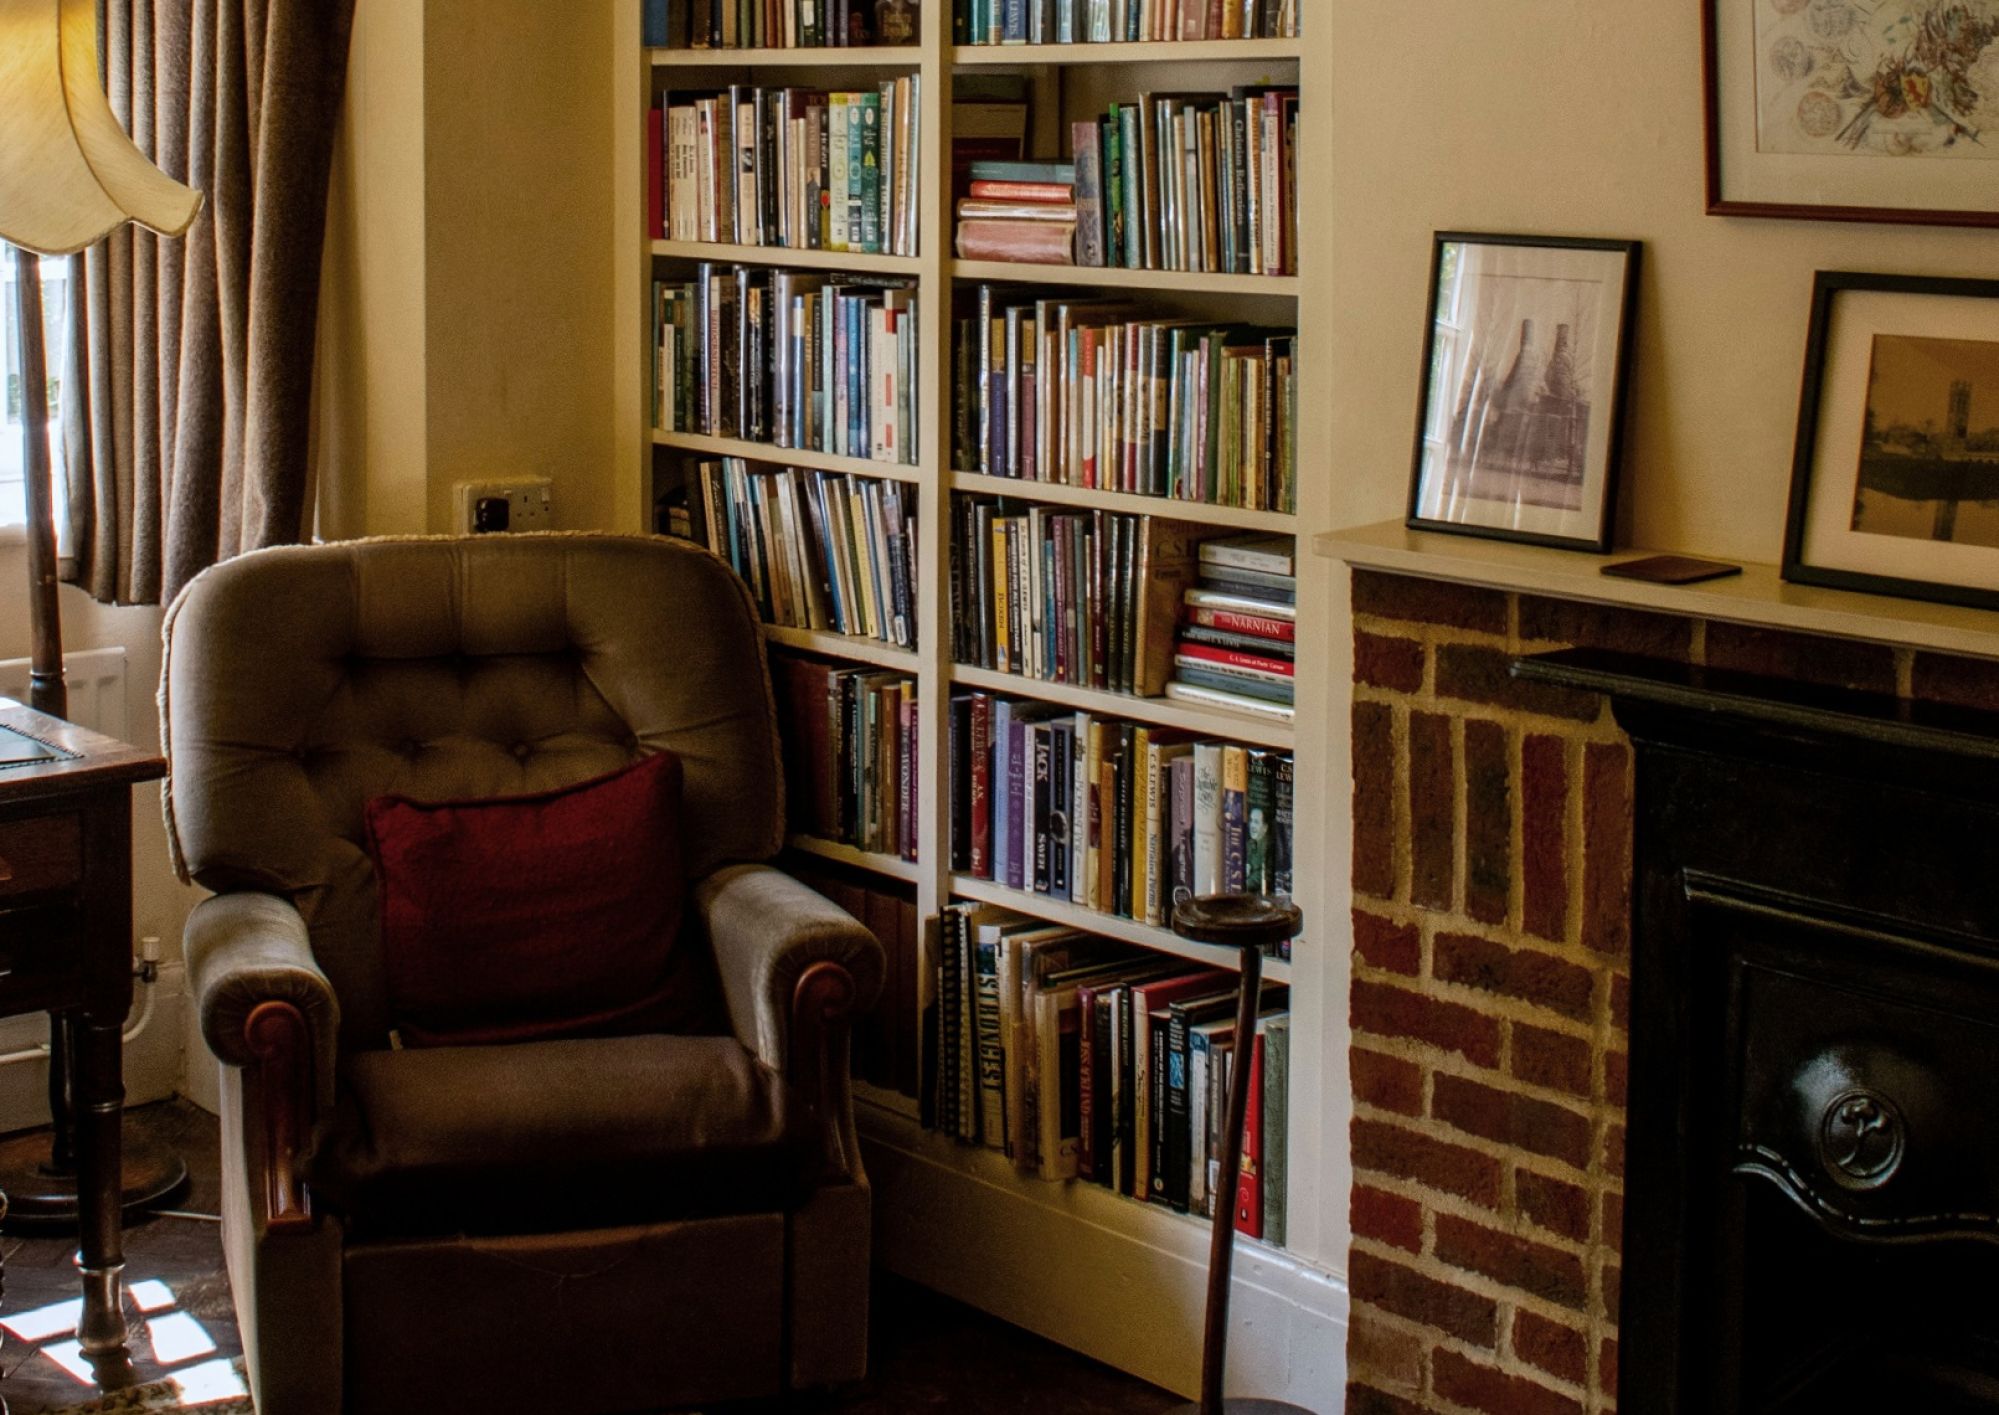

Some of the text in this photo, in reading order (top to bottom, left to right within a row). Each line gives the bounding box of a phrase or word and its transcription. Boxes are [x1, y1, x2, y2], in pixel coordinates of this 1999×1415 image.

[1236, 119, 1246, 226] Christian Reflections
[1231, 615, 1280, 635] NARNIAN
[1036, 739, 1050, 783] JACK
[1276, 771, 1293, 783] LEW
[902, 754, 911, 812] WONDER
[1149, 773, 1157, 809] LEWIS
[1037, 833, 1046, 871] SAYER
[1179, 837, 1187, 883] Laughter
[1149, 878, 1157, 907] Poems
[977, 976, 1003, 1092] STRONGEST
